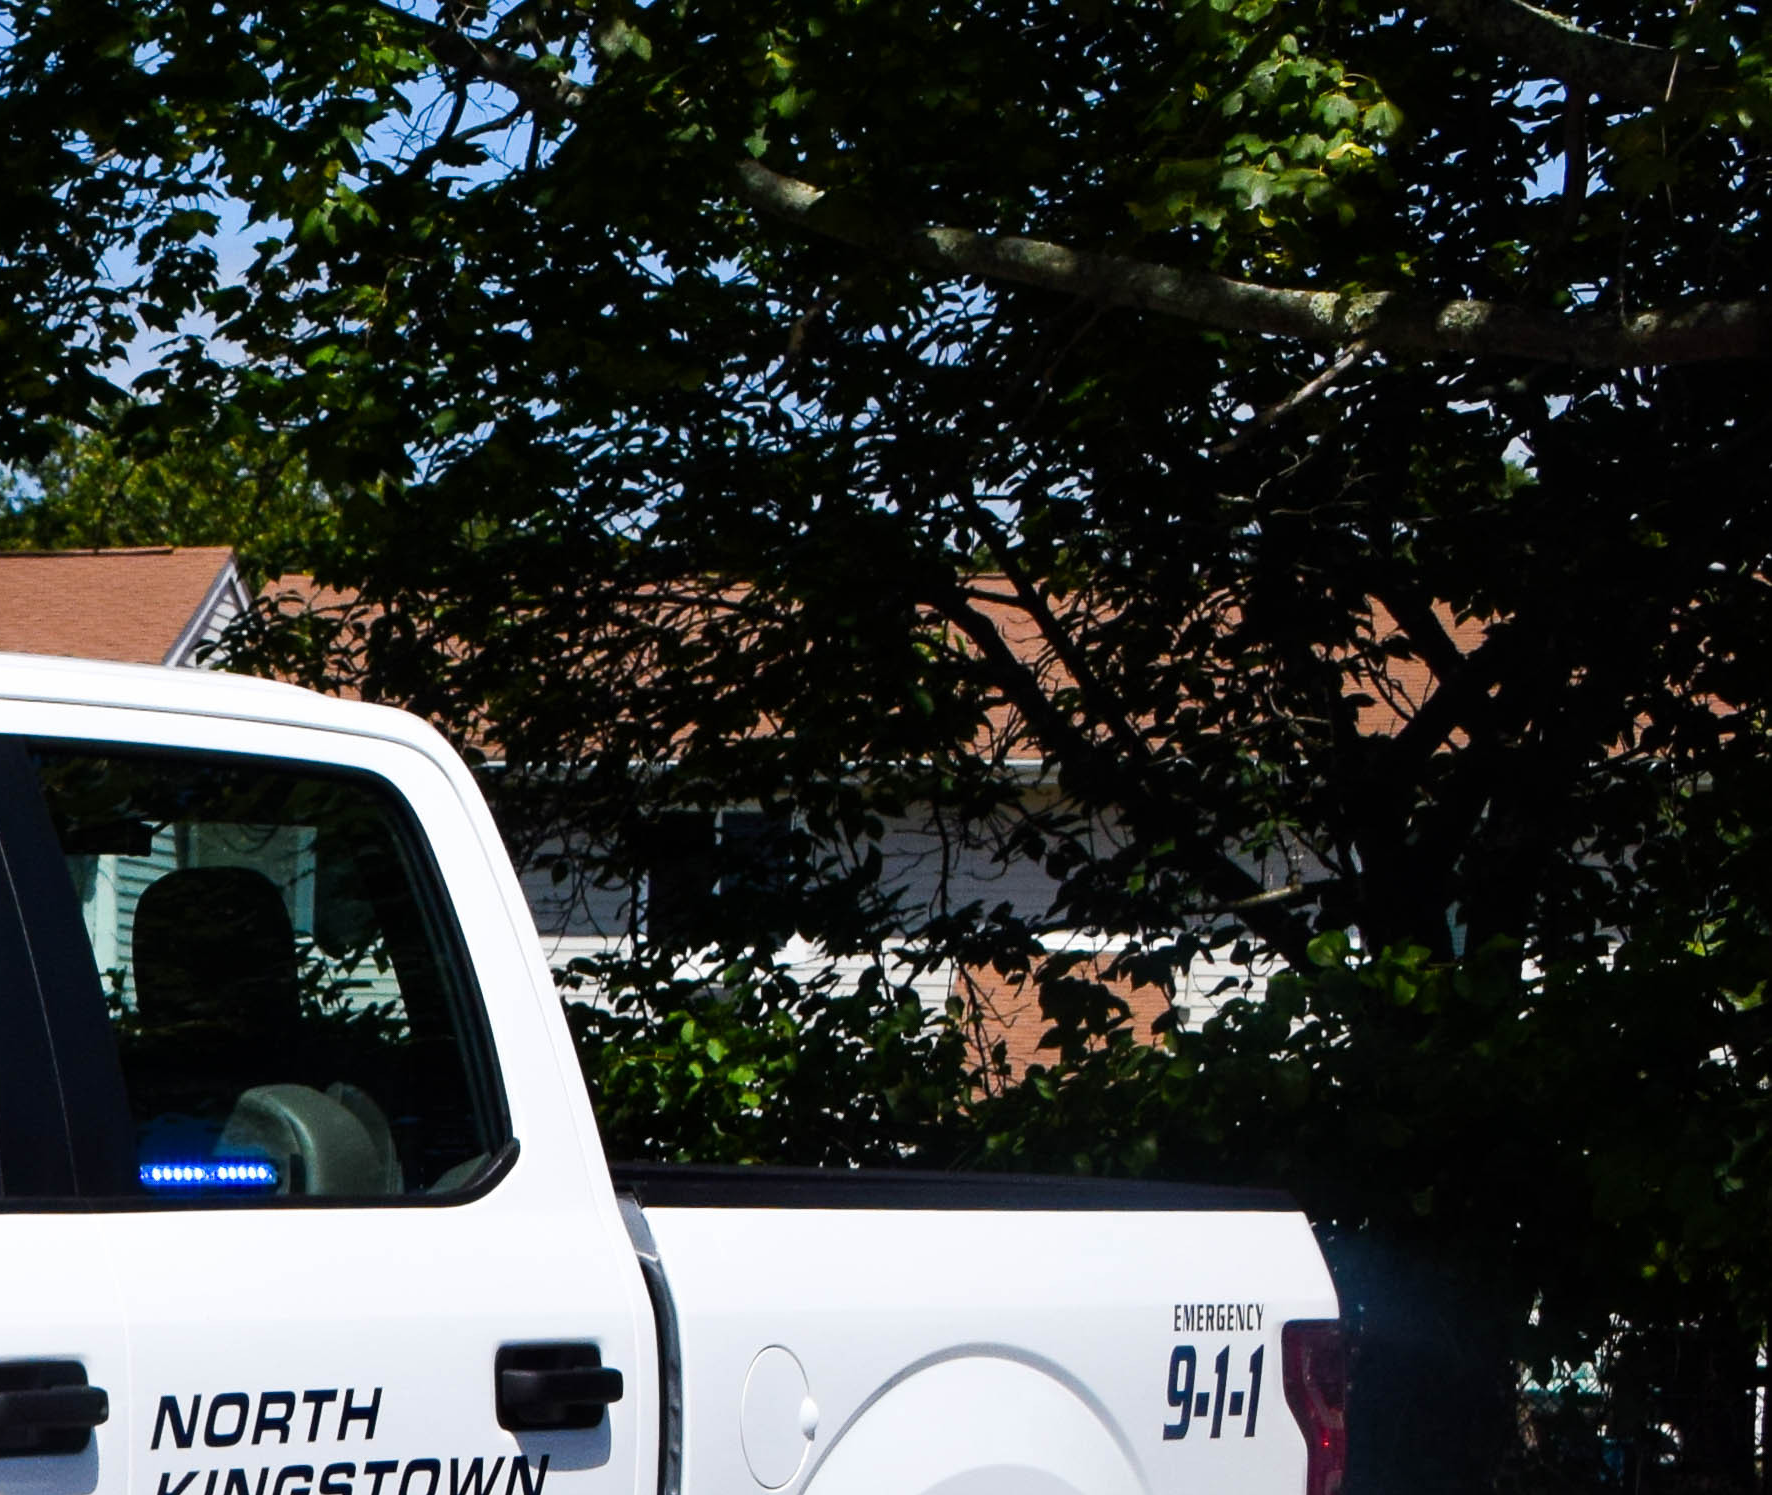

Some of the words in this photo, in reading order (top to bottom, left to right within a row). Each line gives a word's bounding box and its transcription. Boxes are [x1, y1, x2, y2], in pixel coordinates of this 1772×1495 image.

[1173, 1303, 1265, 1332] EMERGENCY
[150, 1387, 384, 1450] NORTH
[1162, 1343, 1265, 1441] 9-1-1
